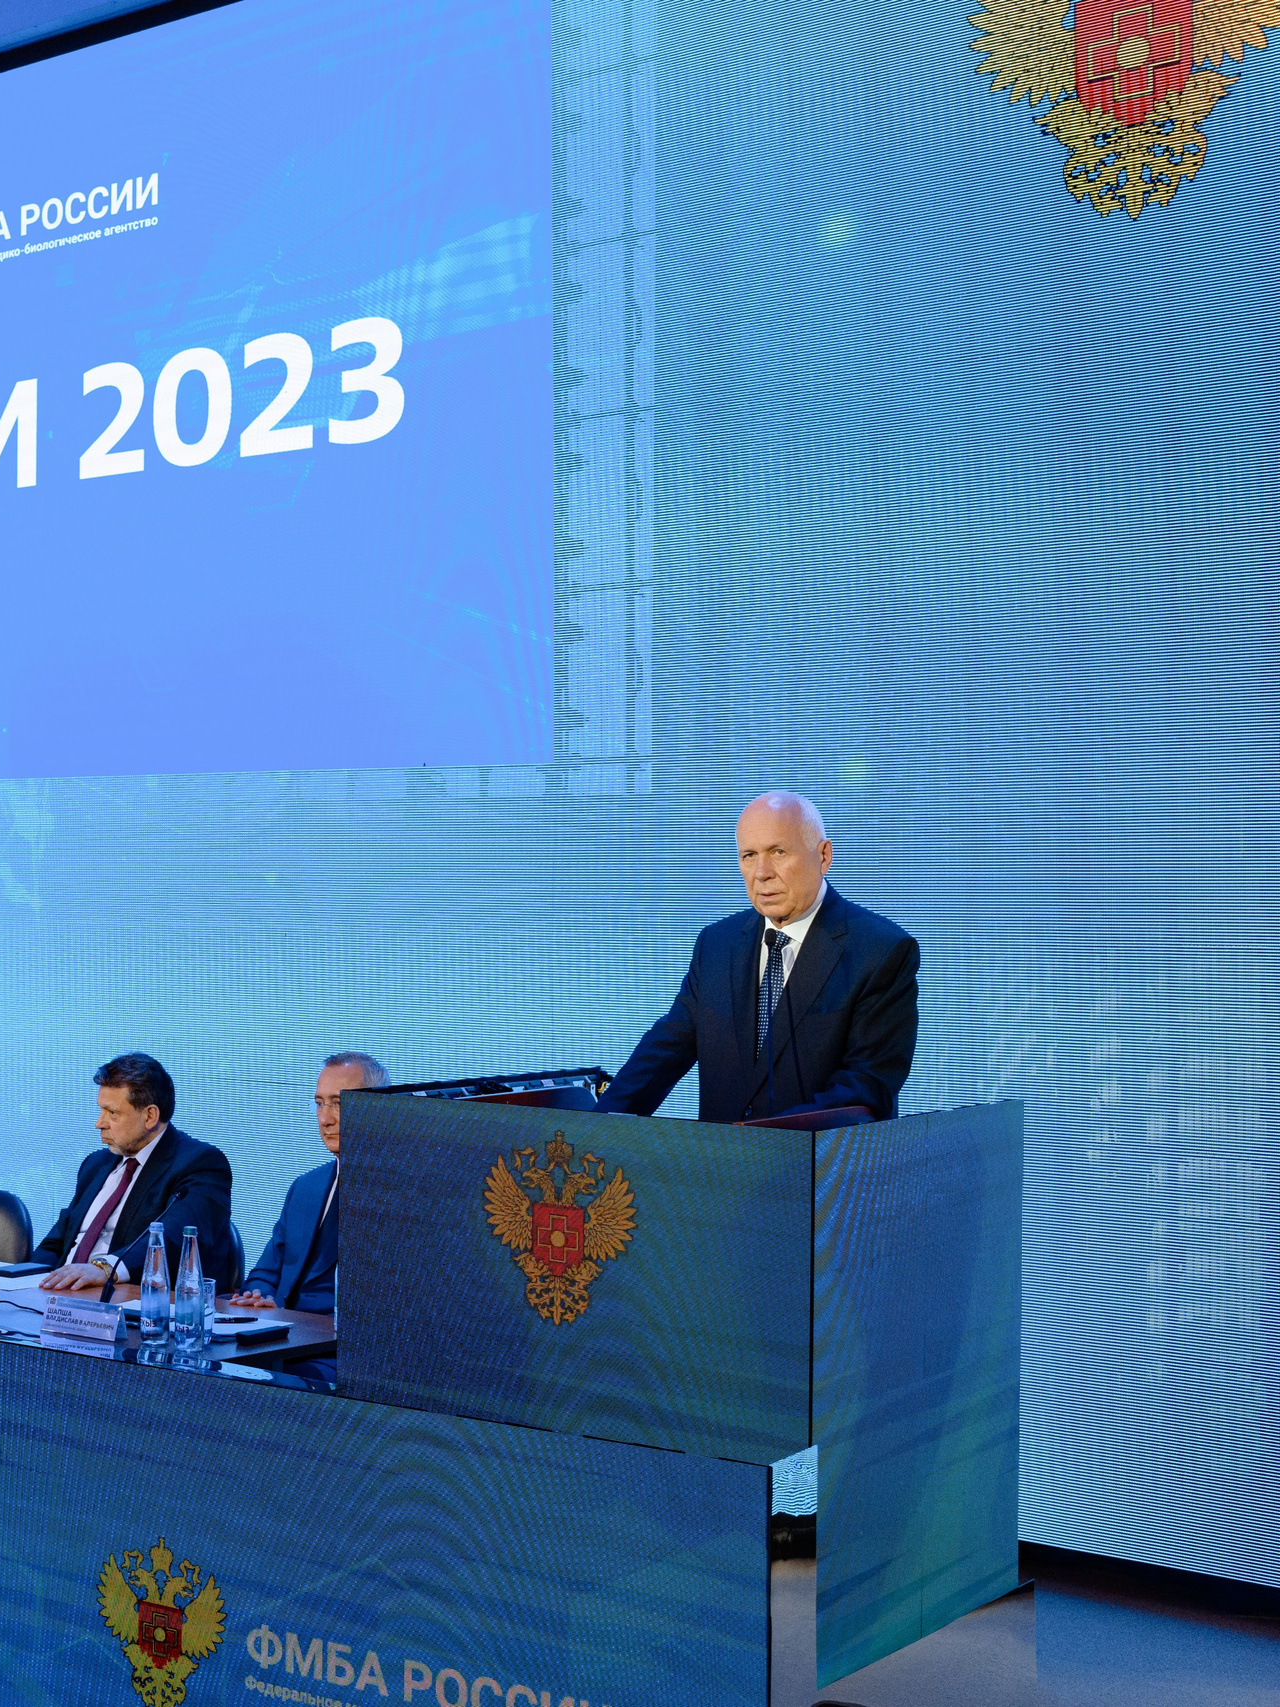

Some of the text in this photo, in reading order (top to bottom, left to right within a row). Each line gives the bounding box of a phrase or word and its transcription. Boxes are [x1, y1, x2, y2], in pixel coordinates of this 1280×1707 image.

[20, 173, 159, 236] РОССИИ
[104, 216, 158, 237] агентство
[79, 316, 406, 480] 2023
[45, 1314, 79, 1325] ВЛАДИСЛАВ
[78, 1319, 114, 1331] ВАЛЕРЬЕВИЧ
[47, 1307, 72, 1317] ШАПША
[246, 1624, 388, 1697] ФМБА
